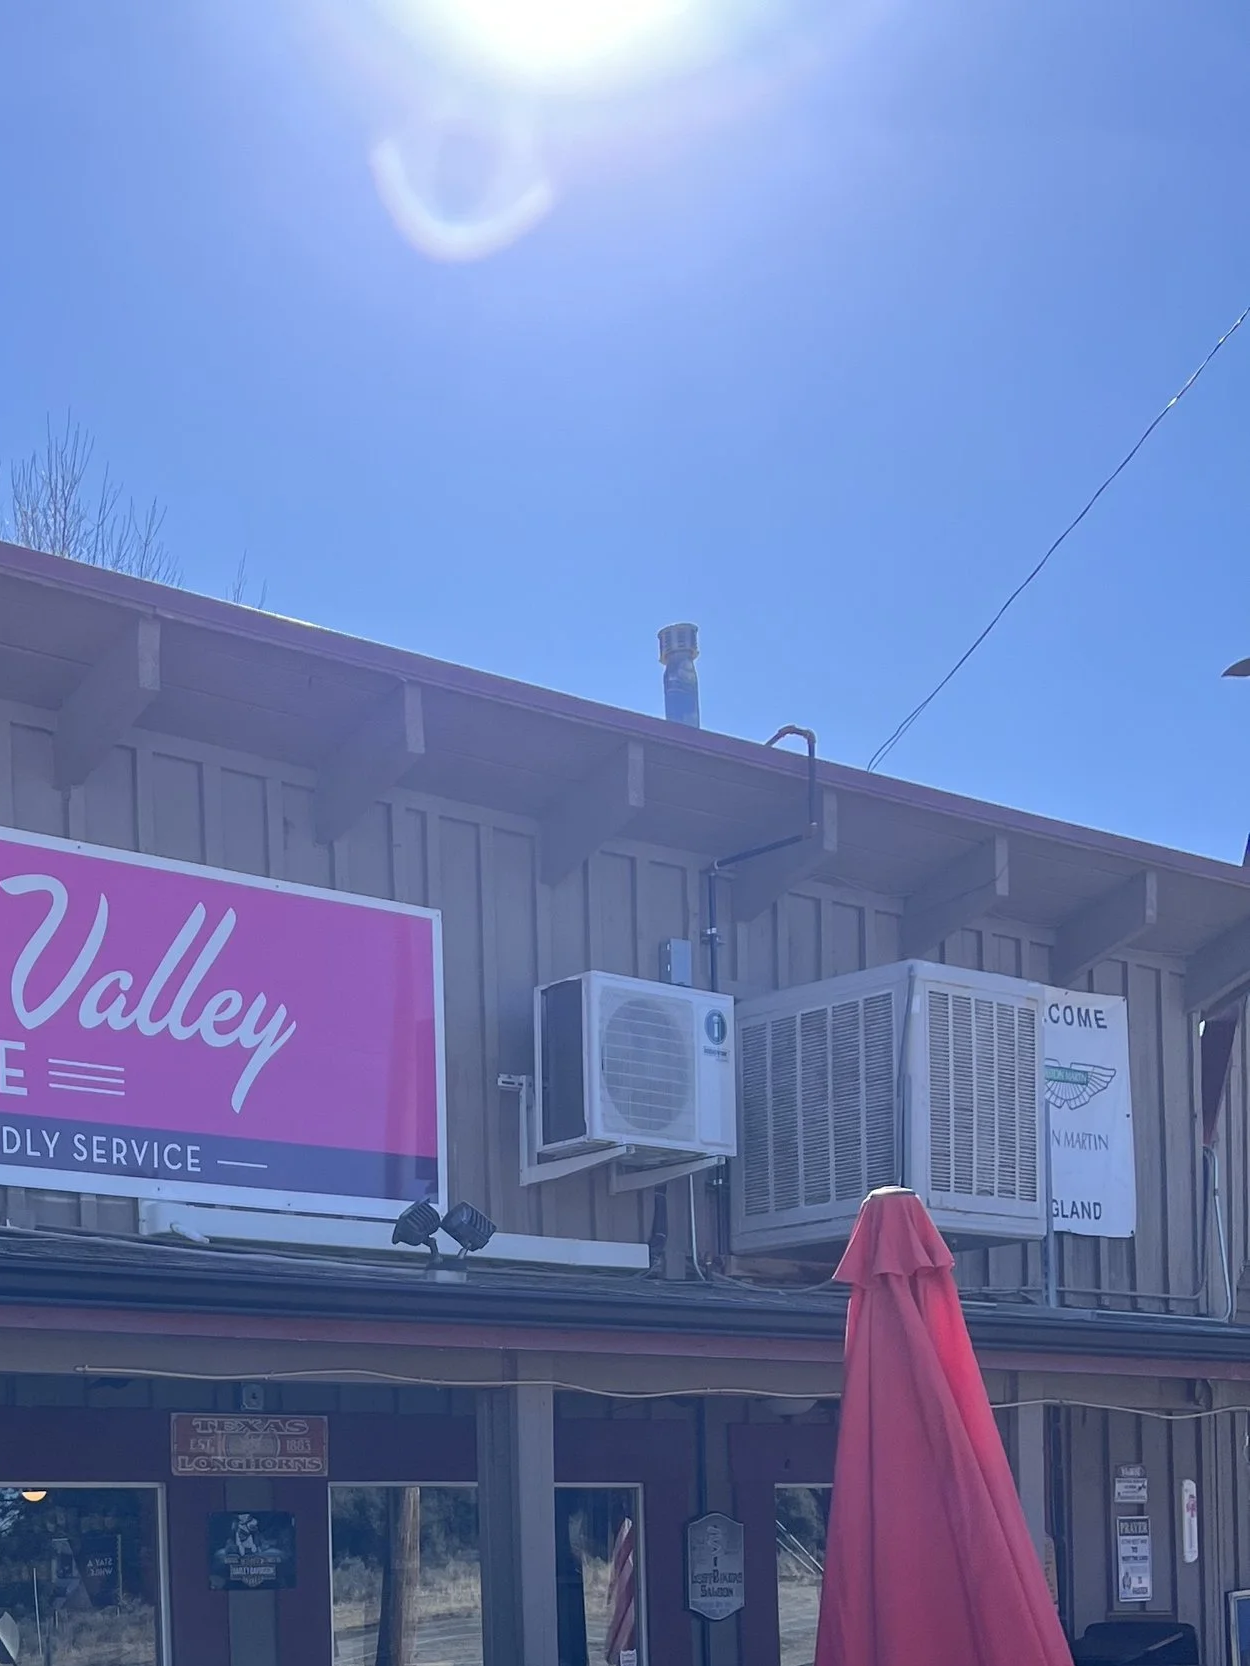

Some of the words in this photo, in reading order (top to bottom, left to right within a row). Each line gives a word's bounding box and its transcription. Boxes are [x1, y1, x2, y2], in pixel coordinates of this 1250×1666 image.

[1044, 1003, 1108, 1029] COME
[1064, 1130, 1109, 1151] MARTIN
[72, 1133, 201, 1172] SERVICE
[1052, 1198, 1102, 1220] GLAND
[192, 1417, 310, 1435] TEXAS
[178, 1456, 323, 1472] LONGHORNS
